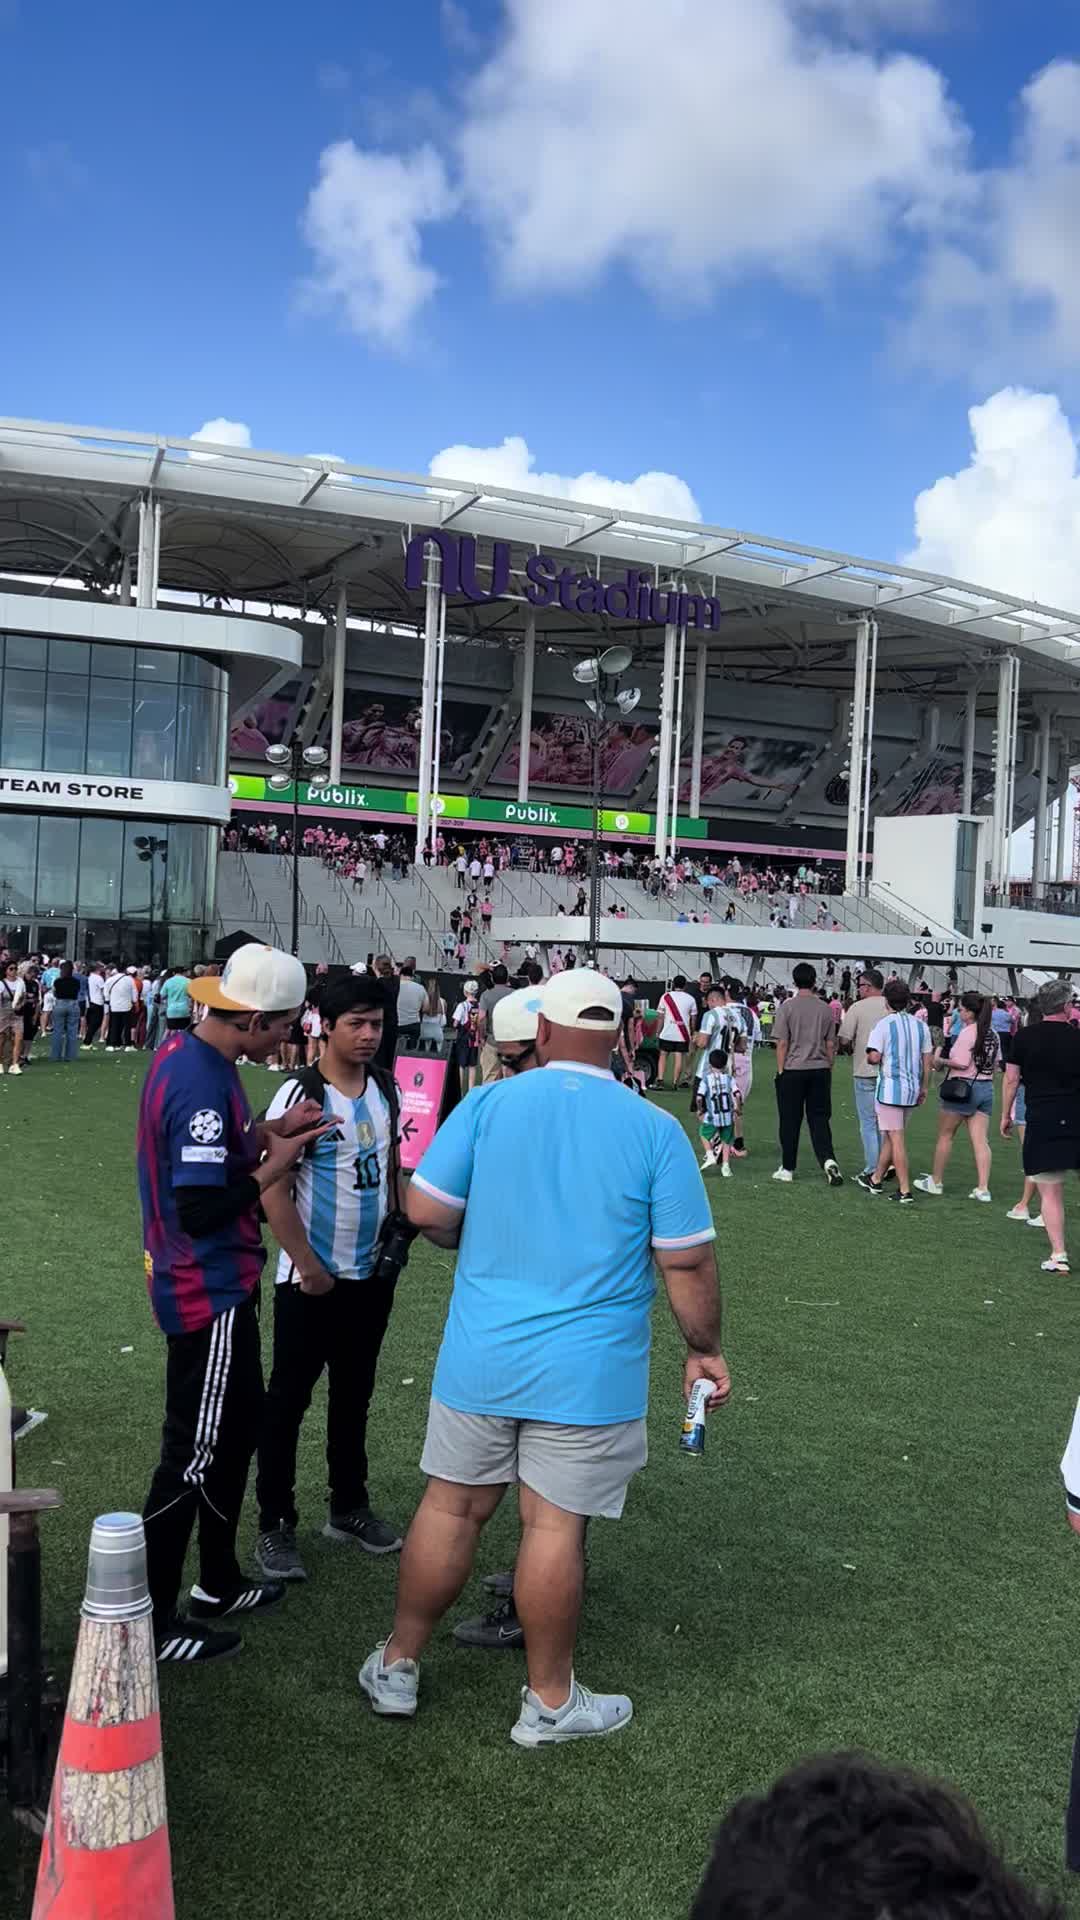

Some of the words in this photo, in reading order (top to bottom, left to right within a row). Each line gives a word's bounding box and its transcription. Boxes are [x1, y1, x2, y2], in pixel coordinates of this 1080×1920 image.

[527, 554, 721, 631] Stadium
[0, 777, 61, 794] TEAM
[67, 783, 144, 800] STORE
[914, 941, 964, 956] SOUTH
[968, 944, 1005, 959] GATE
[711, 1092, 731, 1114] 10
[352, 1152, 381, 1190] 10
